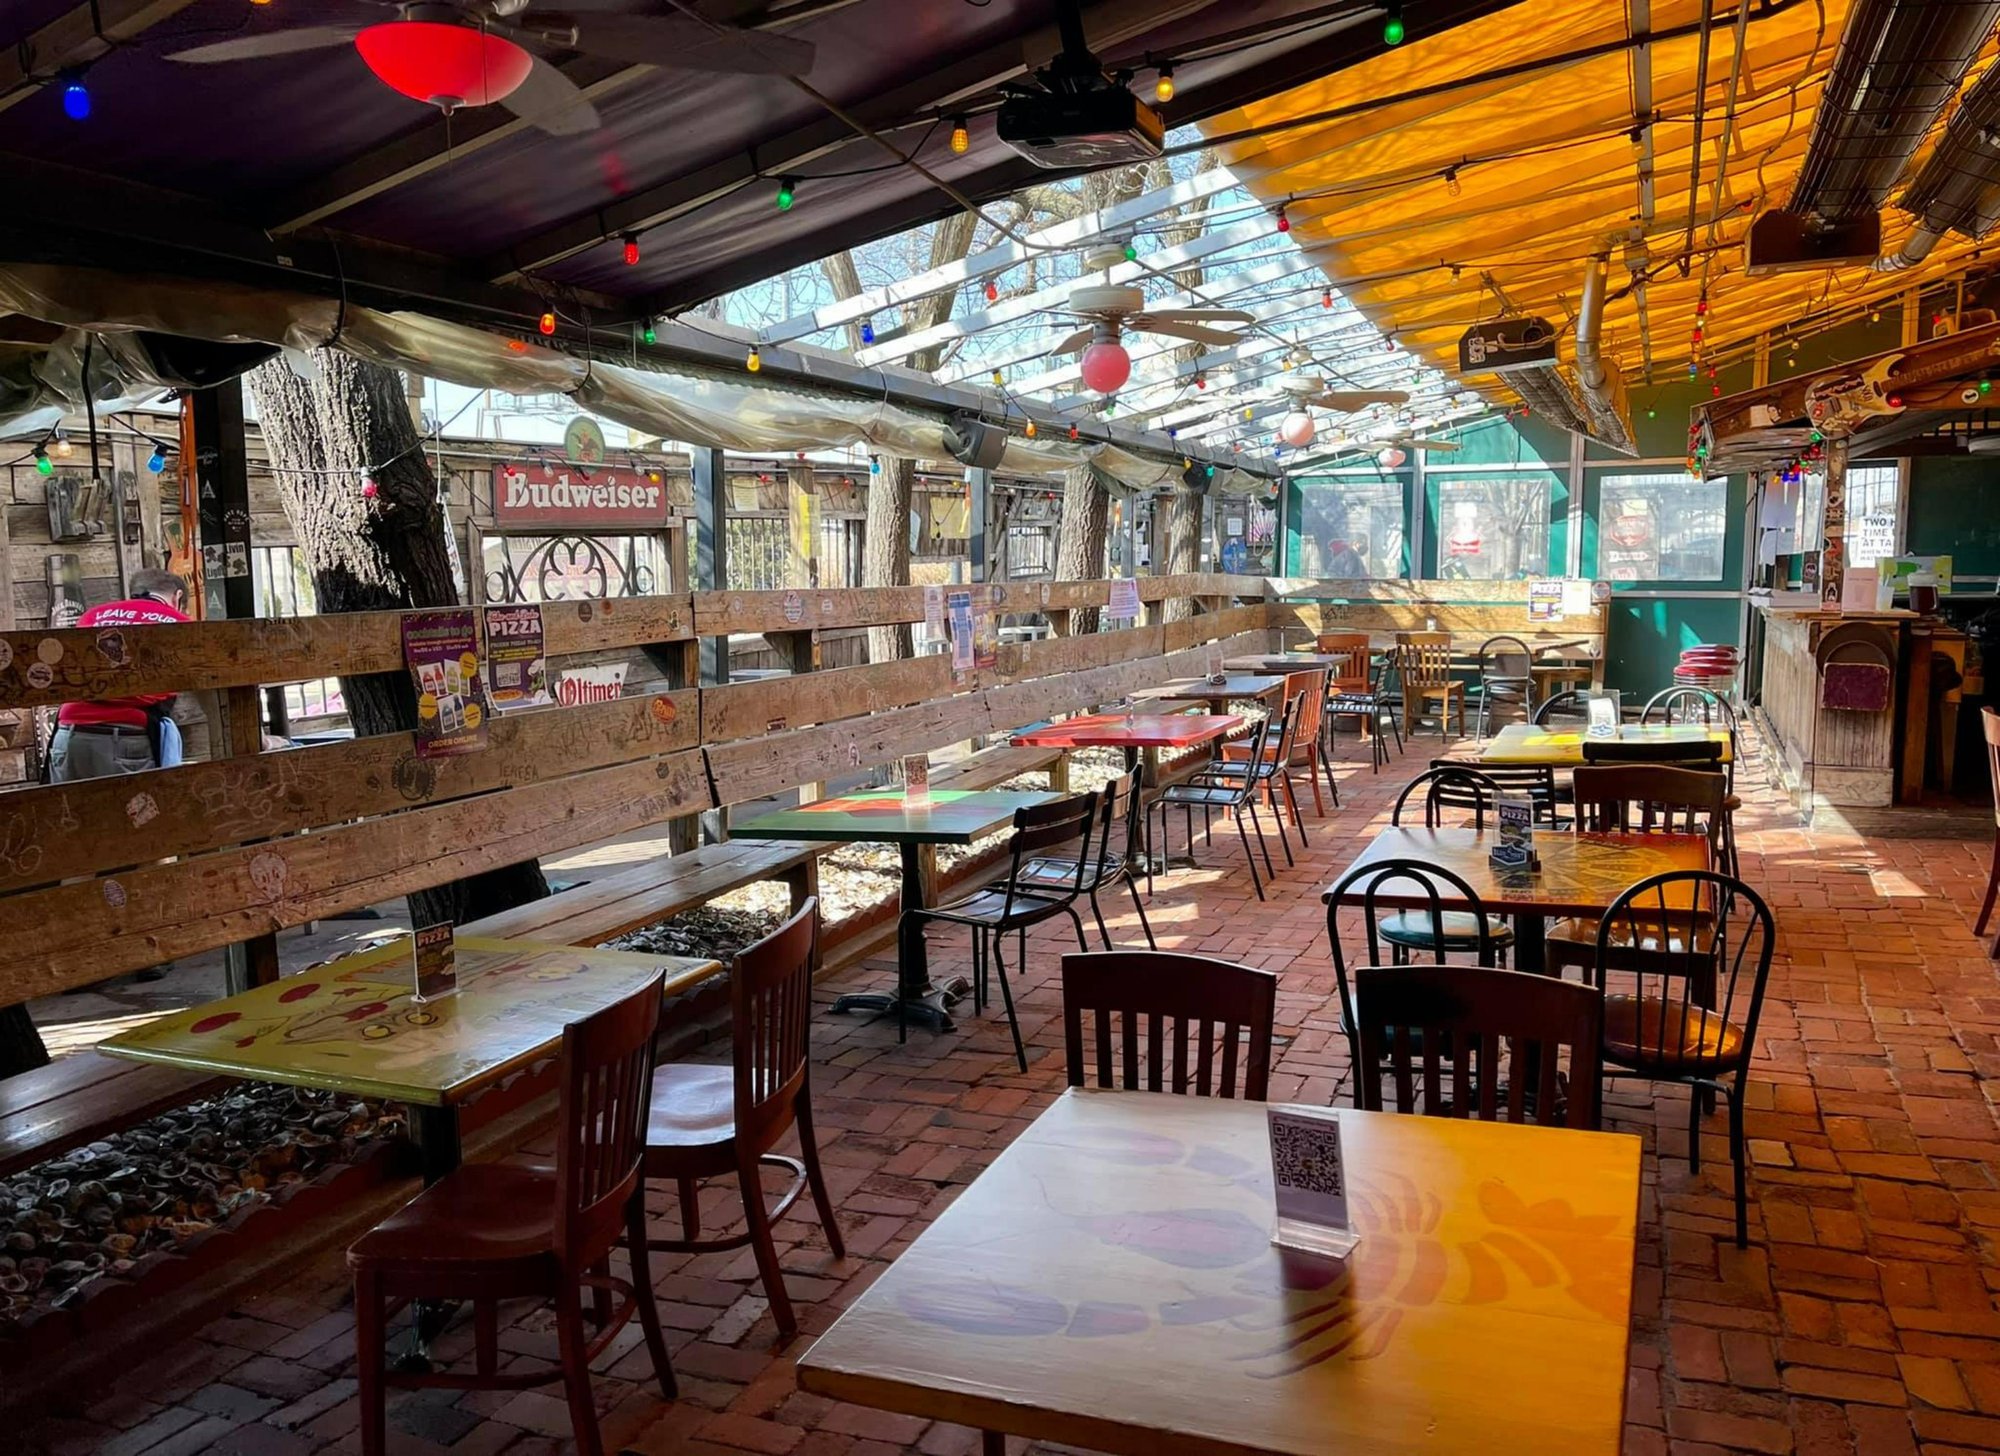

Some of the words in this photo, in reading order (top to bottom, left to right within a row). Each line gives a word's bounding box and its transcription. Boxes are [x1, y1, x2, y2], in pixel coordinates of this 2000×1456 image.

[503, 473, 660, 508] Budweiser
[1864, 518, 1887, 526] TWO
[1863, 529, 1889, 537] TIME
[1863, 539, 1875, 547] AT
[95, 609, 137, 620] LEAVE
[489, 620, 541, 636] PIZZA
[428, 738, 453, 749] ORDER
[453, 734, 478, 745] ONLINE
[1501, 811, 1529, 821] PIZZA
[417, 929, 451, 948] PIZZA
